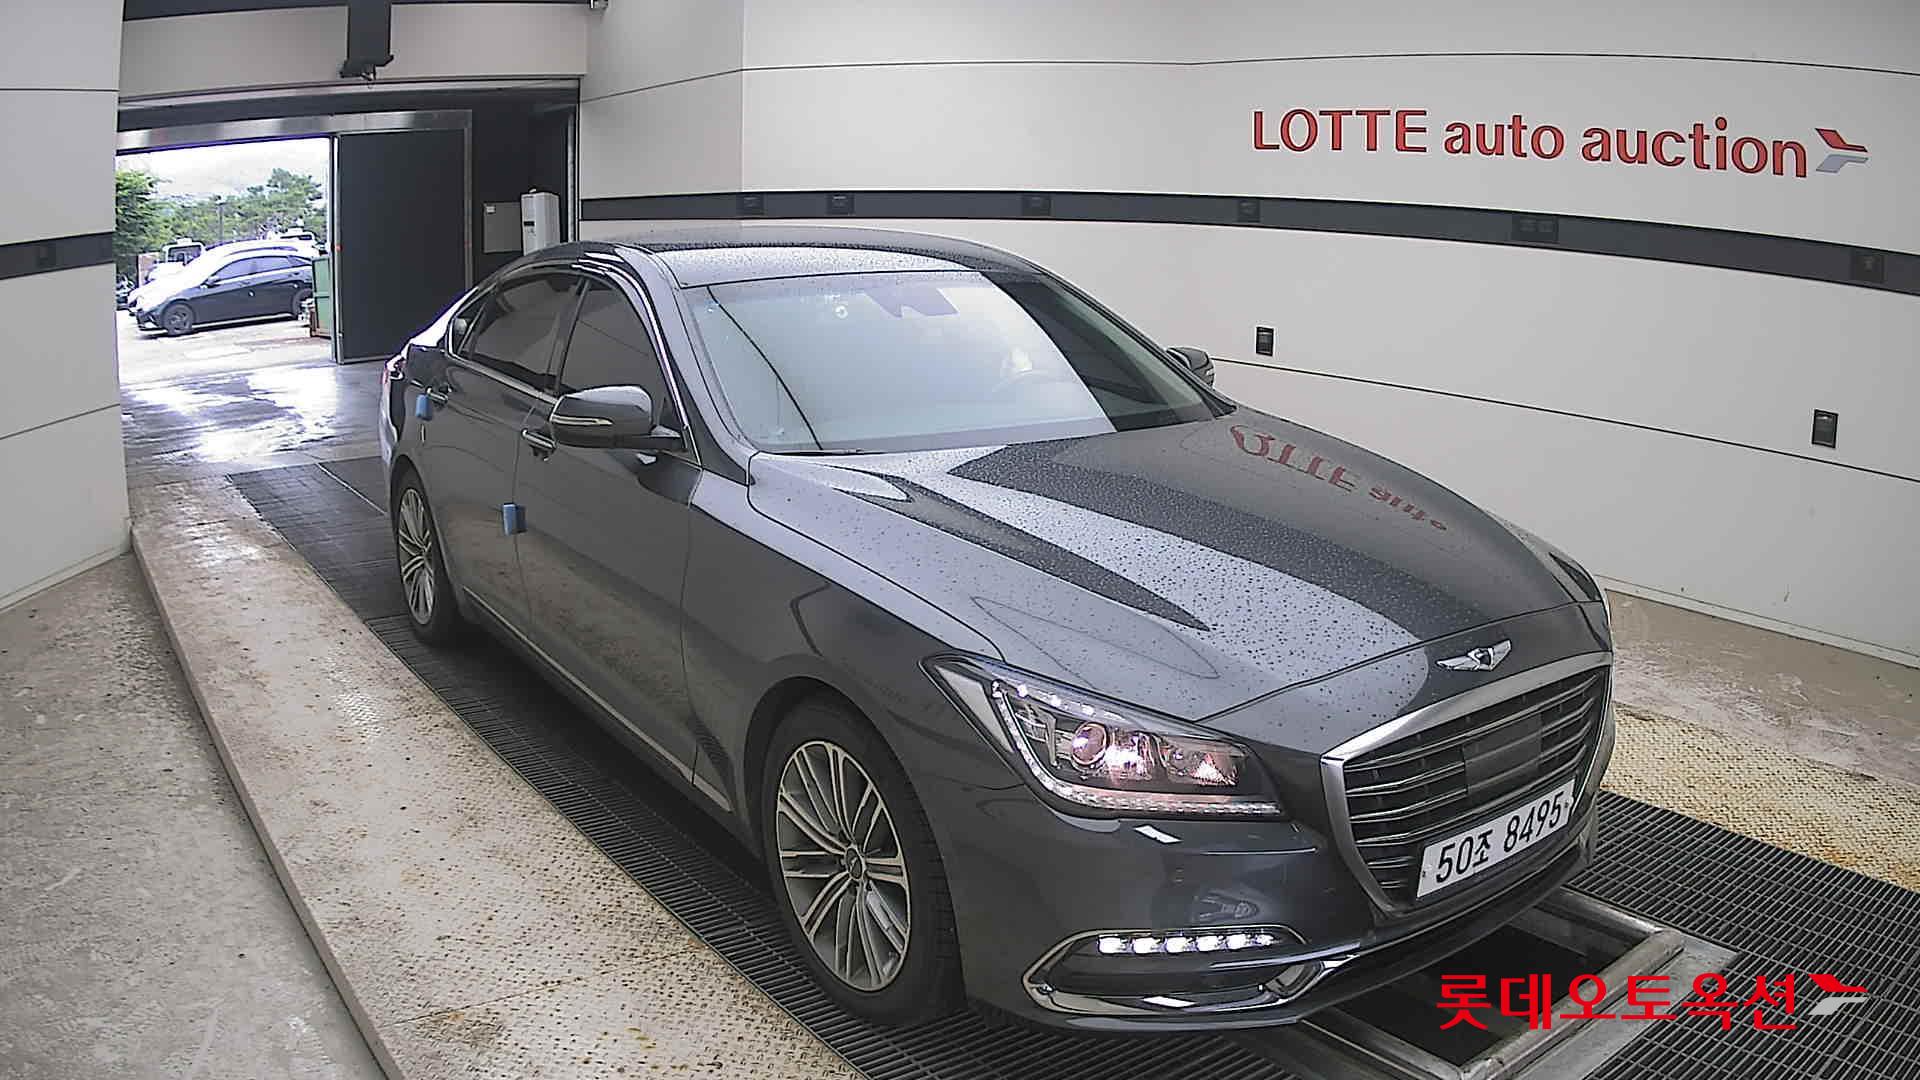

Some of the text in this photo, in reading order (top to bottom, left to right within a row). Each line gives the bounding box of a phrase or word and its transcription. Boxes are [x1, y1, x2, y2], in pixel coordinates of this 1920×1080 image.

[1253, 109, 1808, 177] LOTTE auto auction
[1435, 790, 1564, 883] 50조 8495
